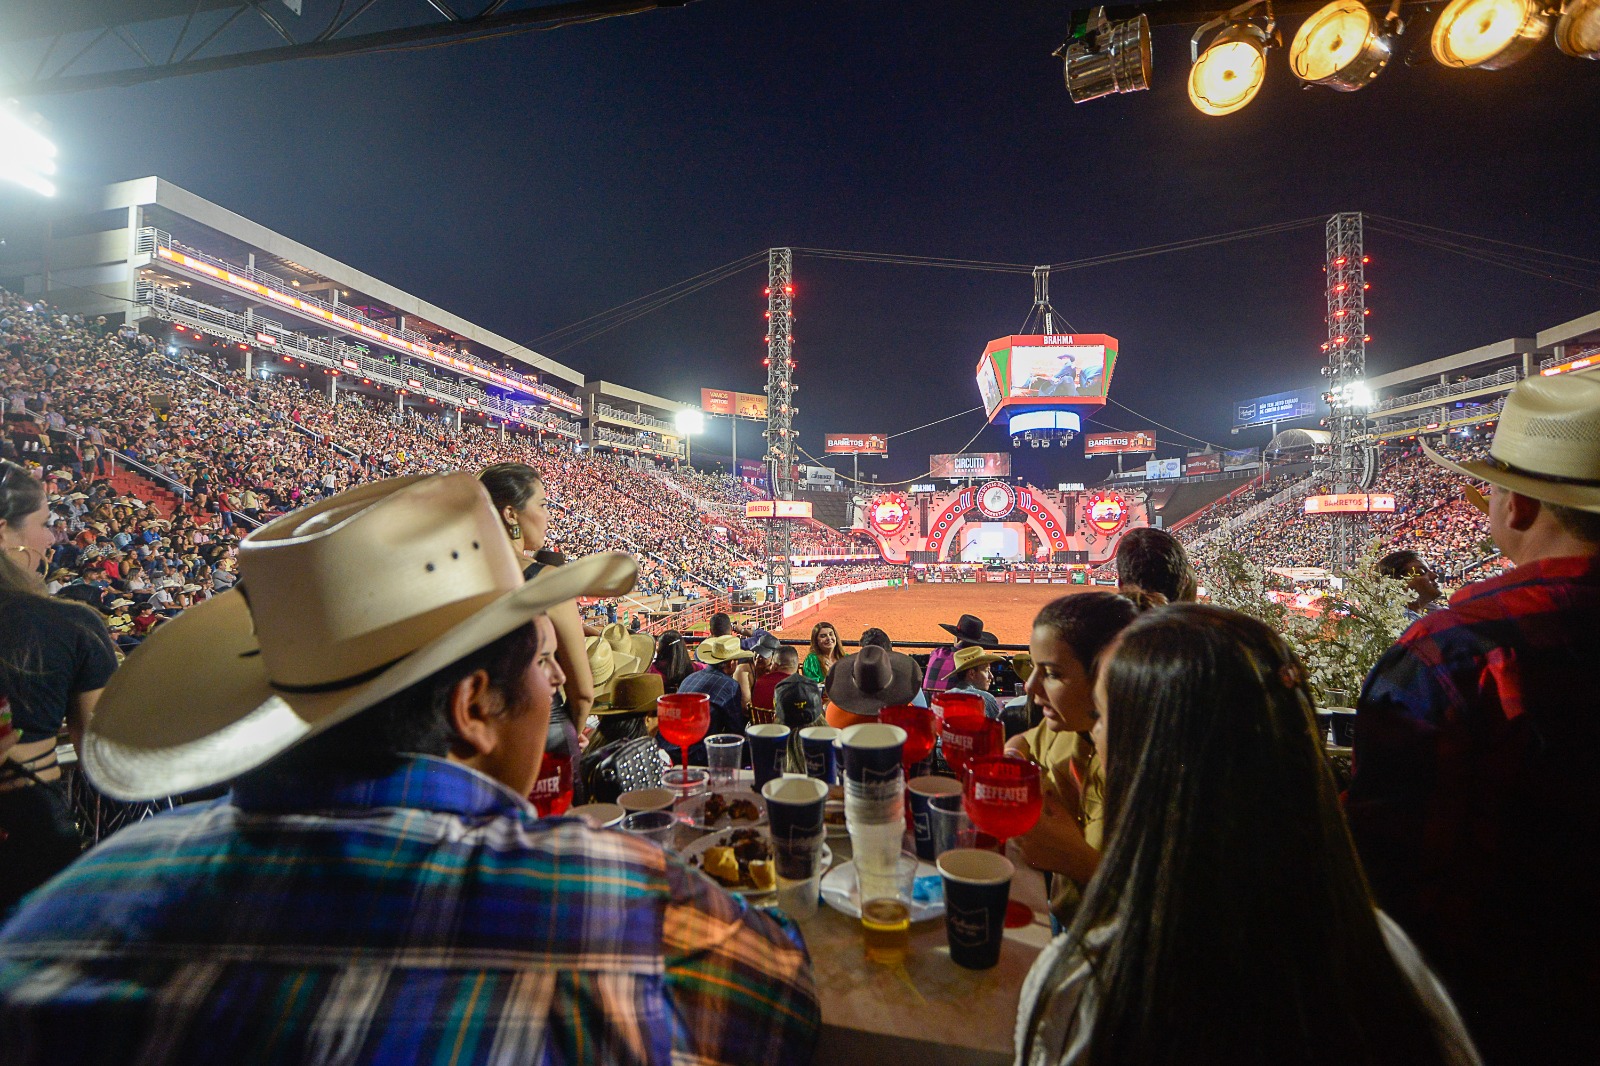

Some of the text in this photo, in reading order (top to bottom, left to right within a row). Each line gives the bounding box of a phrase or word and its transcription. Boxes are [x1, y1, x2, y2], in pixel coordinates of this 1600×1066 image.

[1043, 335, 1074, 345] BRAHMA
[709, 391, 728, 399] VAMOS
[1088, 438, 1129, 448] BARRETOS
[954, 457, 985, 469] CIRCUITO
[1058, 482, 1085, 492] BRAHMA
[1324, 498, 1363, 507] BARRETOS
[983, 508, 1008, 517] BARRETOS
[975, 782, 1028, 804] BEEFEATER
